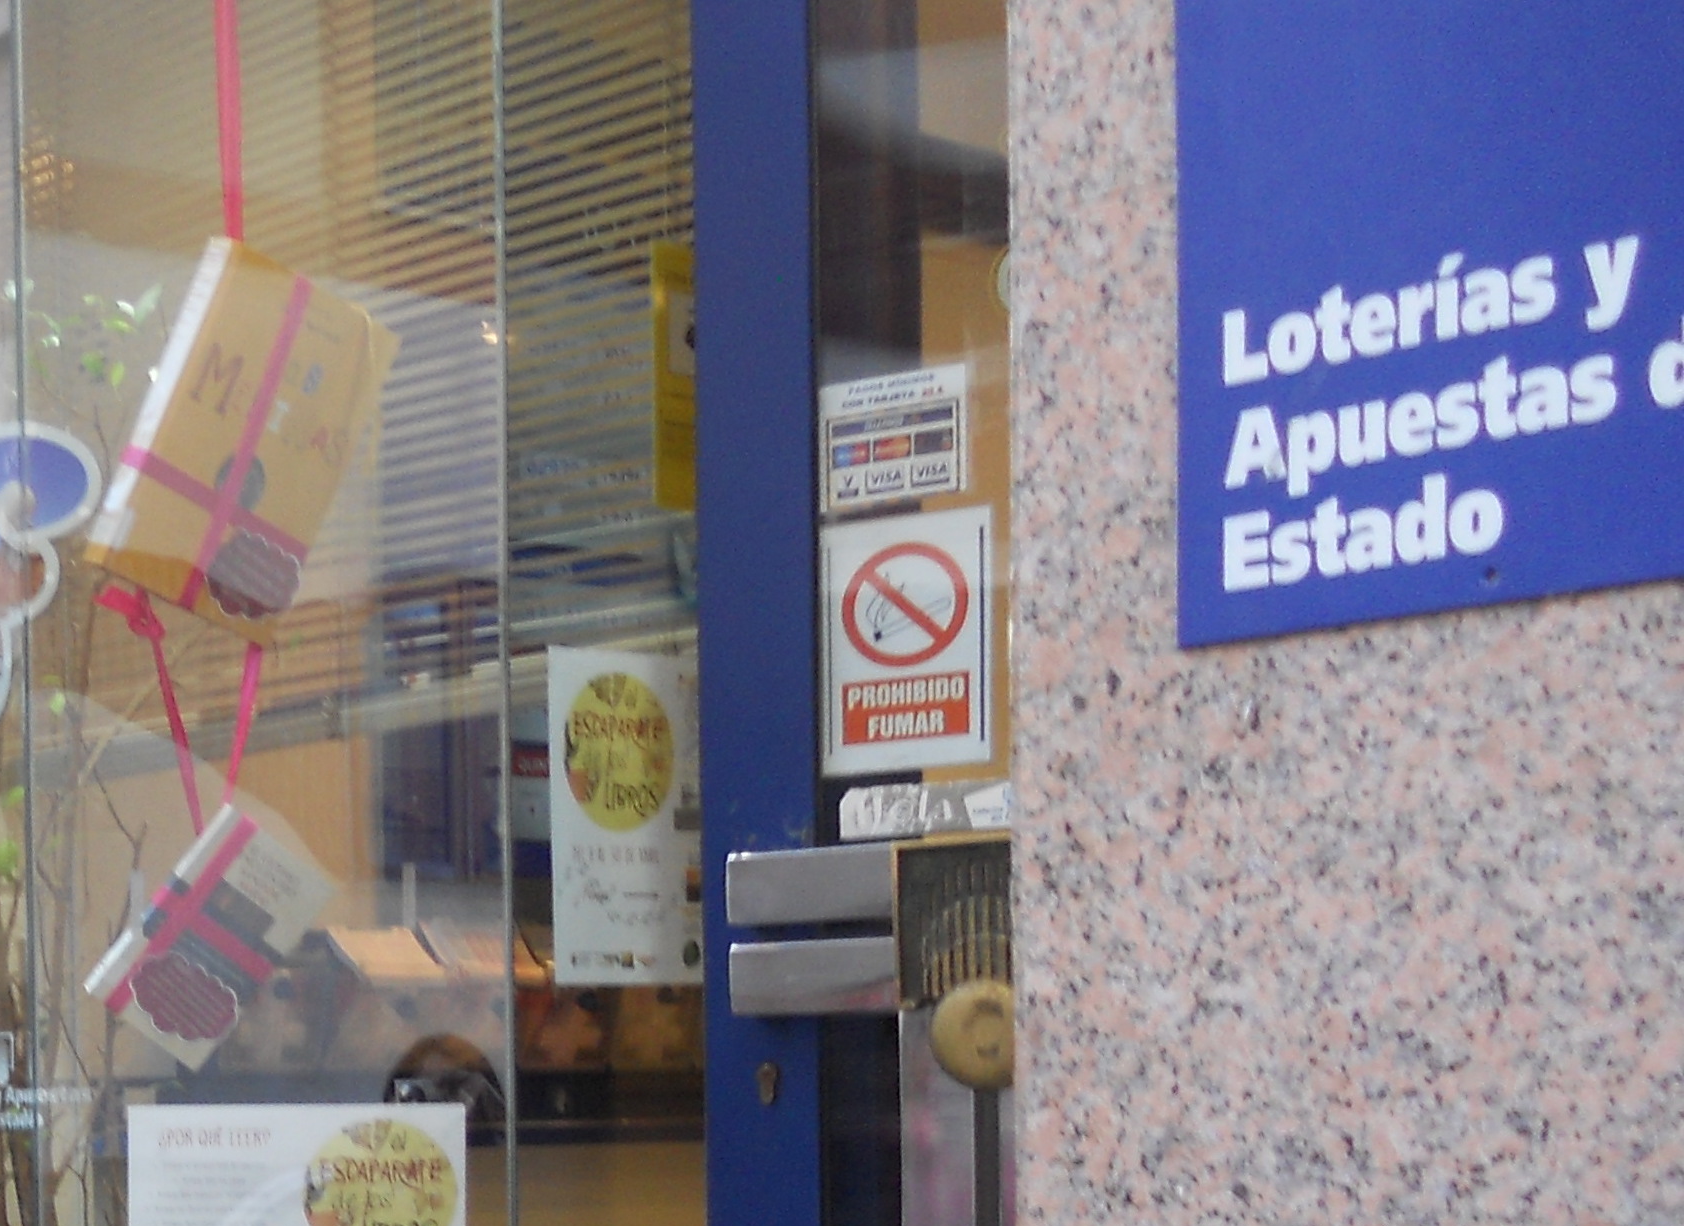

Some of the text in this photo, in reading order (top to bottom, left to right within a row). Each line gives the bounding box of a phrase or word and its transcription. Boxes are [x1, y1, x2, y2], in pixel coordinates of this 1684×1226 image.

[1223, 235, 1640, 387] Loterías y
[1224, 356, 1617, 497] Apuestas
[872, 470, 902, 485] VISA
[917, 463, 948, 478] VISA
[1223, 473, 1504, 592] Estado
[847, 675, 965, 712] PROHIBIDO
[868, 709, 945, 739] FUMAR
[605, 782, 661, 817] LIBROS
[319, 1157, 444, 1188] ESCAPARATE
